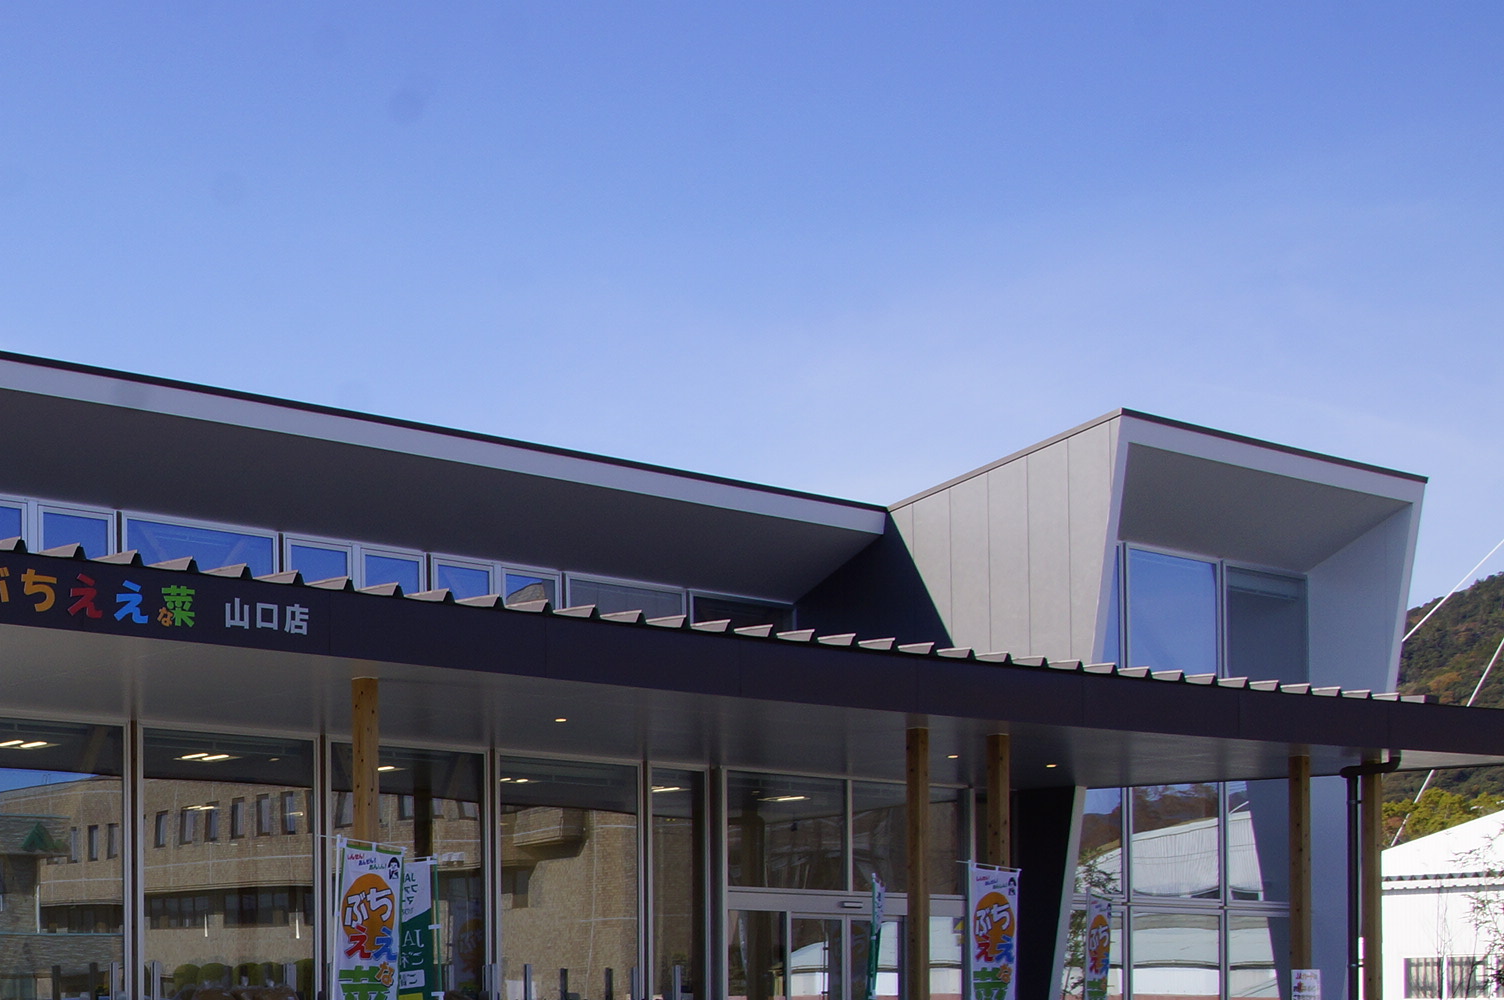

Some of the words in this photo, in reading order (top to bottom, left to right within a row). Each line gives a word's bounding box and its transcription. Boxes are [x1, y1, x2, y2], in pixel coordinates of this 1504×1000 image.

[225, 598, 309, 635] 山口店
[344, 887, 393, 927] ぶち
[975, 902, 1011, 938] ぶち
[344, 925, 397, 962] ええ
[975, 934, 1015, 964] ええ
